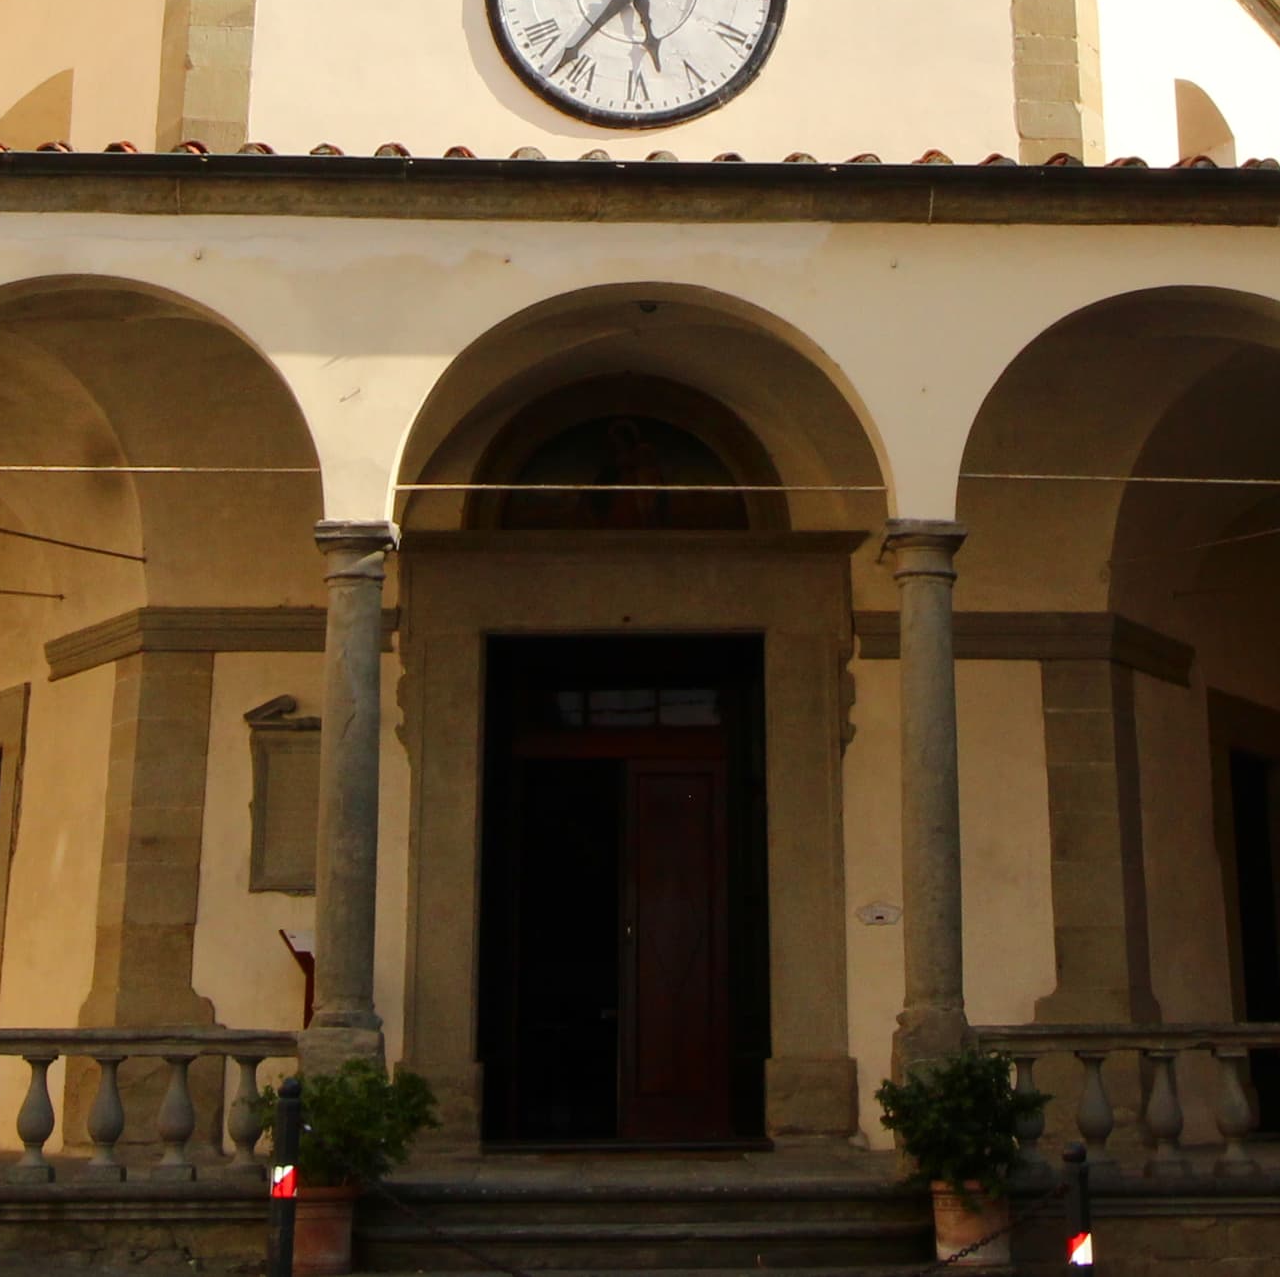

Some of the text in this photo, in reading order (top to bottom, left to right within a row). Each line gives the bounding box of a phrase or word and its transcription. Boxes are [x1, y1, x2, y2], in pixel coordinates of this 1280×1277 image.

[524, 17, 561, 58] VIII
[566, 53, 597, 93] VII
[626, 69, 650, 102] VI
[682, 59, 707, 91] V
